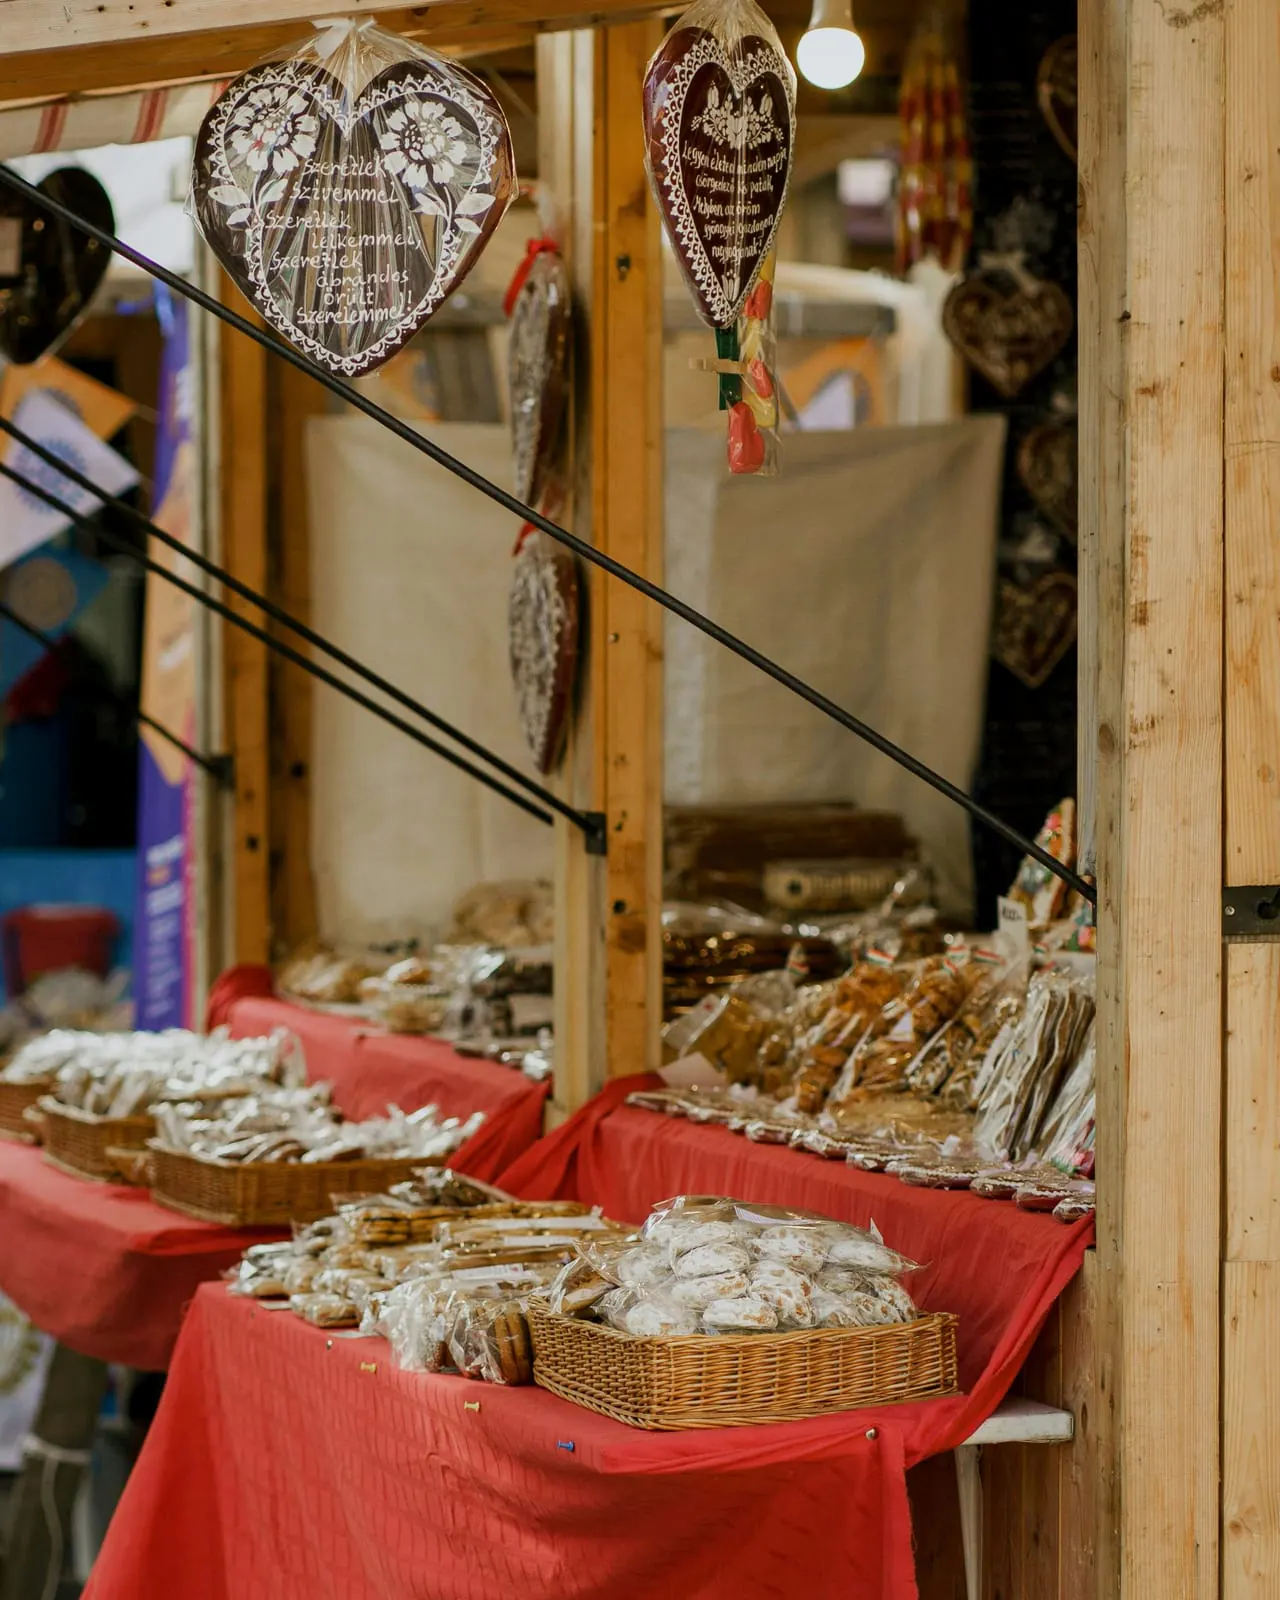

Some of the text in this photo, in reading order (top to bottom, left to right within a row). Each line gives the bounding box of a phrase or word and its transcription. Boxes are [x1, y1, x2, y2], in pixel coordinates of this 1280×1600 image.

[302, 155, 387, 178] Szeretlek
[265, 210, 351, 229] Szeretlek
[269, 250, 363, 270] Szeretlek
